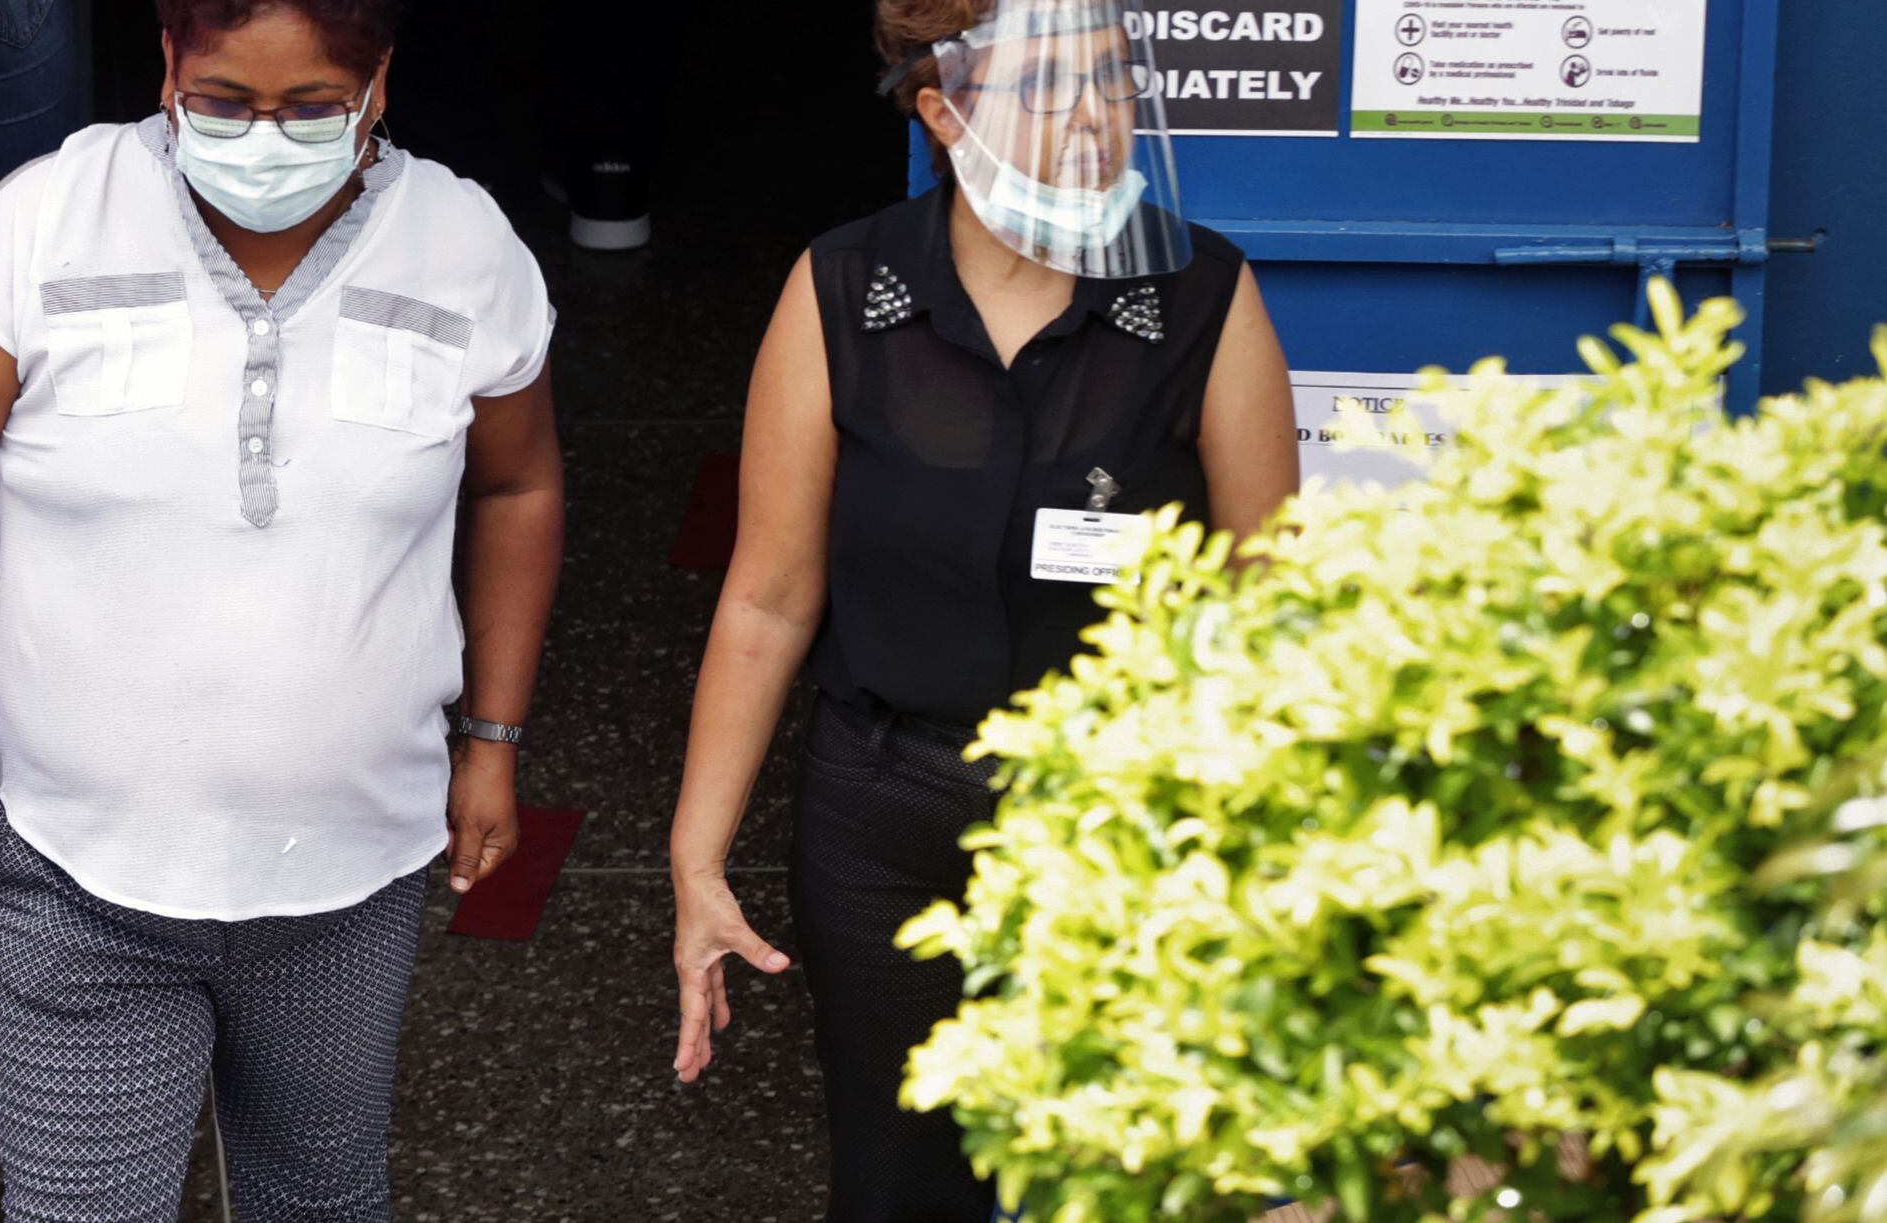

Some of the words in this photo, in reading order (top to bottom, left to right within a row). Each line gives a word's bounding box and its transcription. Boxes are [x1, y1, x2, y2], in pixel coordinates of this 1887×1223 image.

[1123, 11, 1324, 42] DISCARD
[1132, 65, 1322, 100] DIATELY
[1035, 563, 1089, 575] PRESIDING
